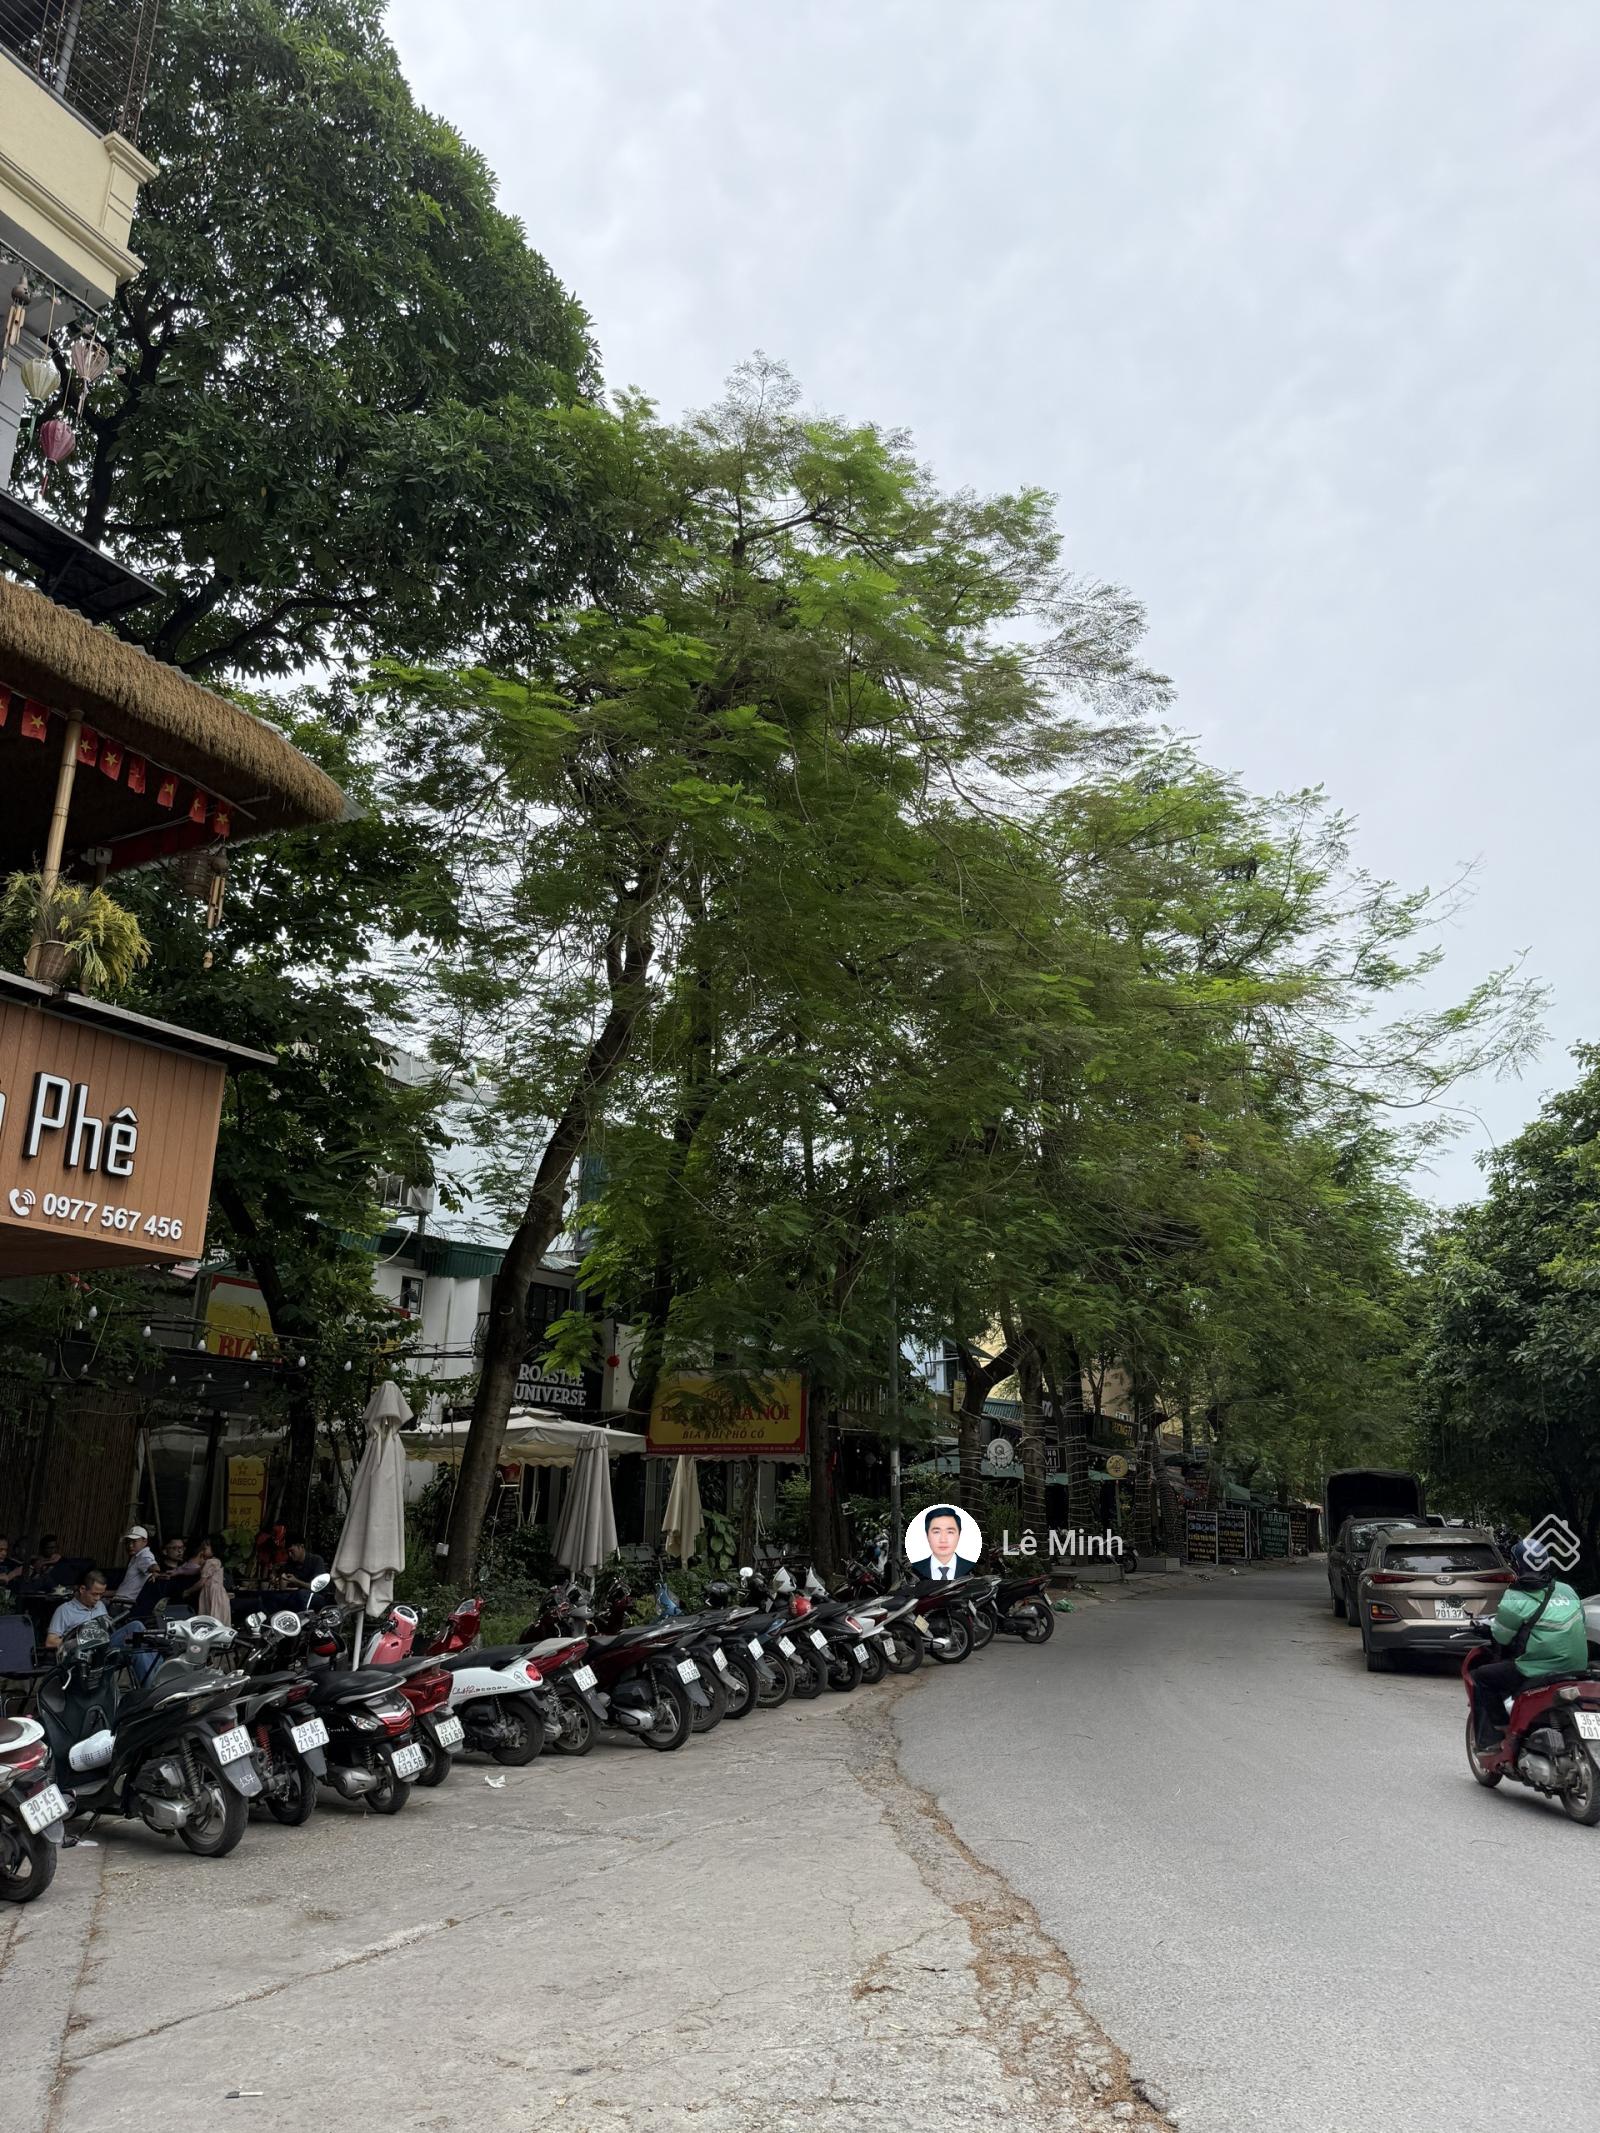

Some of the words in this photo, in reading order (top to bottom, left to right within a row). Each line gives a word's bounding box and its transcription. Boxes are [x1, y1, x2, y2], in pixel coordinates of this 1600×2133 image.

[25, 1072, 138, 1177] Phê
[43, 1192, 98, 1223] 0977
[101, 1205, 141, 1232] 567
[143, 1214, 183, 1240] 456
[513, 1382, 587, 1407] UNIVERSE
[220, 1740, 251, 1762] 675.68
[297, 1731, 326, 1750] 219.72
[33, 1802, 63, 1828] 1123
